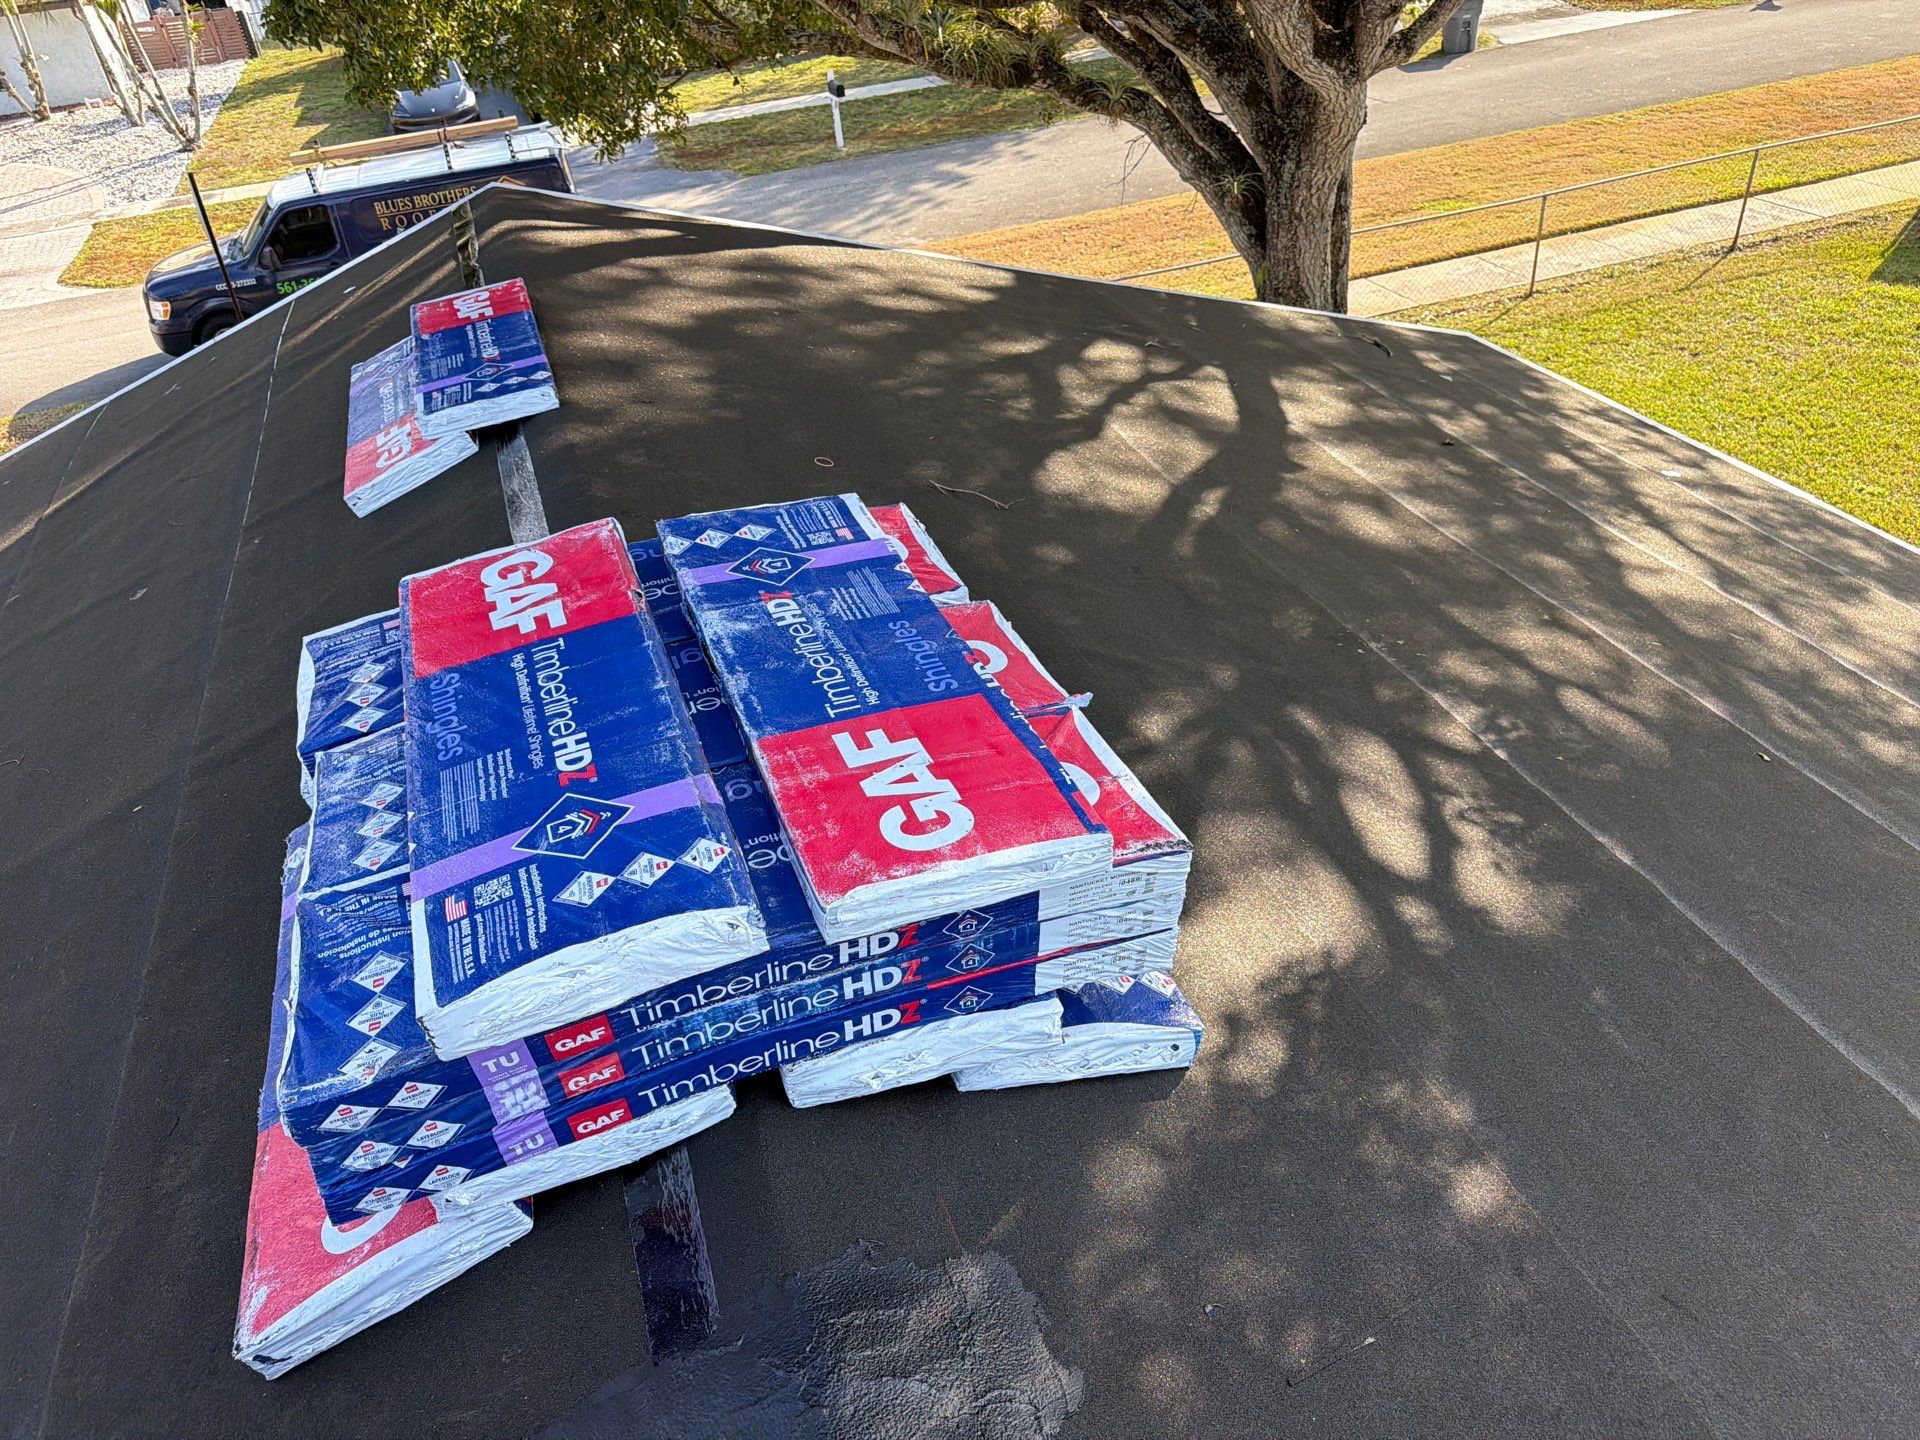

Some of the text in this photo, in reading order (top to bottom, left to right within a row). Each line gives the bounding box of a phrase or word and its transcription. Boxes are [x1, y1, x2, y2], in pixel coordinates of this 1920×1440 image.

[374, 196, 412, 214] BLUES
[453, 290, 494, 320] GAF
[481, 549, 567, 635] GAF
[510, 652, 527, 671] High
[888, 620, 959, 692] Shingles
[861, 683, 880, 706] High
[425, 672, 468, 761] Shingles
[833, 728, 975, 851] GAF
[1070, 876, 1109, 890] NANTUCKET
[359, 895, 371, 906] IN
[459, 917, 470, 937] MADE
[1068, 915, 1106, 927] NANTUCKET
[366, 928, 381, 940] de
[462, 935, 471, 945] IN
[338, 933, 391, 960] instructions
[463, 942, 472, 958] THE
[358, 964, 398, 982] WINDPROVEN
[356, 1010, 394, 1026] STAINGUARD
[368, 1009, 385, 1018] PLUS
[554, 1026, 606, 1052] GAF
[481, 1051, 521, 1073] TU
[567, 1064, 617, 1091] GAF
[396, 1087, 432, 1103] LAYERLOCK
[328, 1108, 368, 1124] STAINGUARD
[341, 1115, 359, 1124] PLUS
[577, 1109, 625, 1134] GAF
[416, 1127, 450, 1142] LAYERLOCK
[508, 1134, 545, 1156] TU
[427, 1171, 460, 1186] LAYERLOCK
[364, 1189, 401, 1205] STAINGUARD
